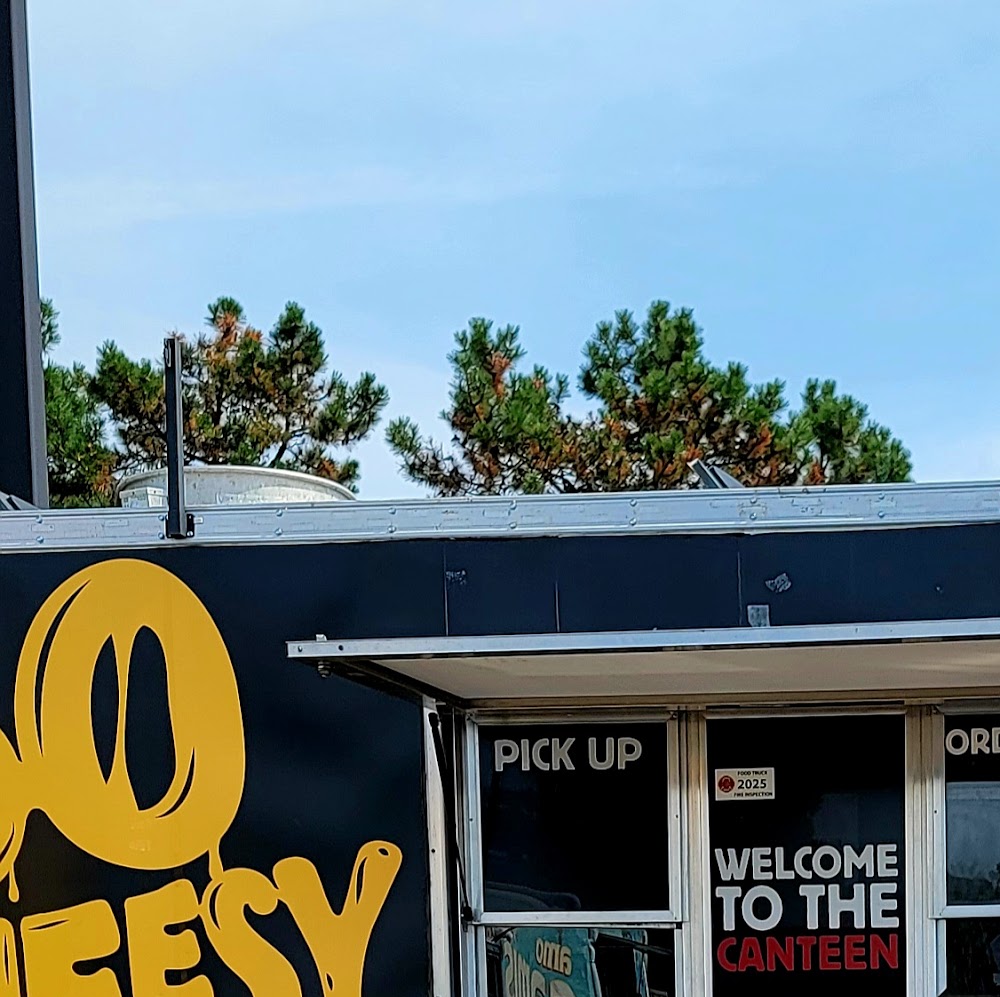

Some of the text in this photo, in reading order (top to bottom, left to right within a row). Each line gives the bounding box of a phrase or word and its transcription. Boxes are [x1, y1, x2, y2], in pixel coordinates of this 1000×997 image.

[494, 737, 642, 772] PICK UP
[738, 778, 767, 790] 2025
[714, 844, 898, 881] WELCOME
[715, 882, 899, 931] TO THE
[717, 933, 899, 972] CANTEEN
